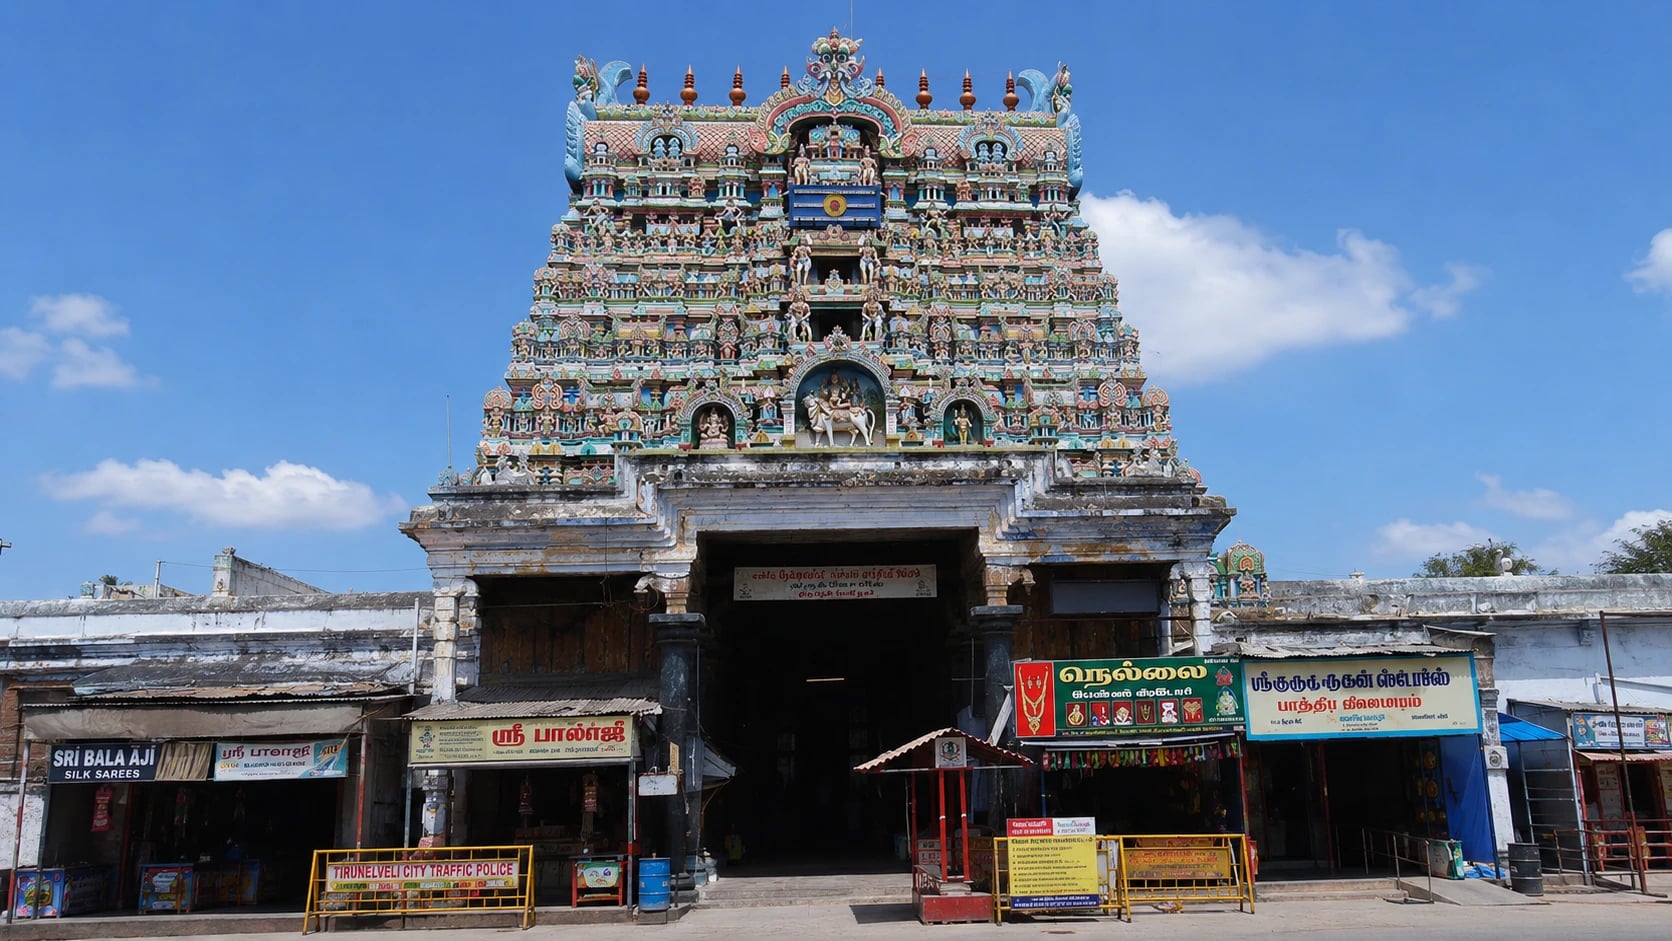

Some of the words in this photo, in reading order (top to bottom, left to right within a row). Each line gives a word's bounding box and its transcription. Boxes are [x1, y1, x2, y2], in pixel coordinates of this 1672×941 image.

[84, 749, 125, 766] BALA
[64, 770, 91, 779] SILK
[95, 769, 140, 779] SAREES
[334, 865, 400, 879] TIRUNELVELI
[403, 864, 427, 878] CITY
[430, 863, 473, 877] TRAFFIC
[476, 863, 513, 876] POLICE
